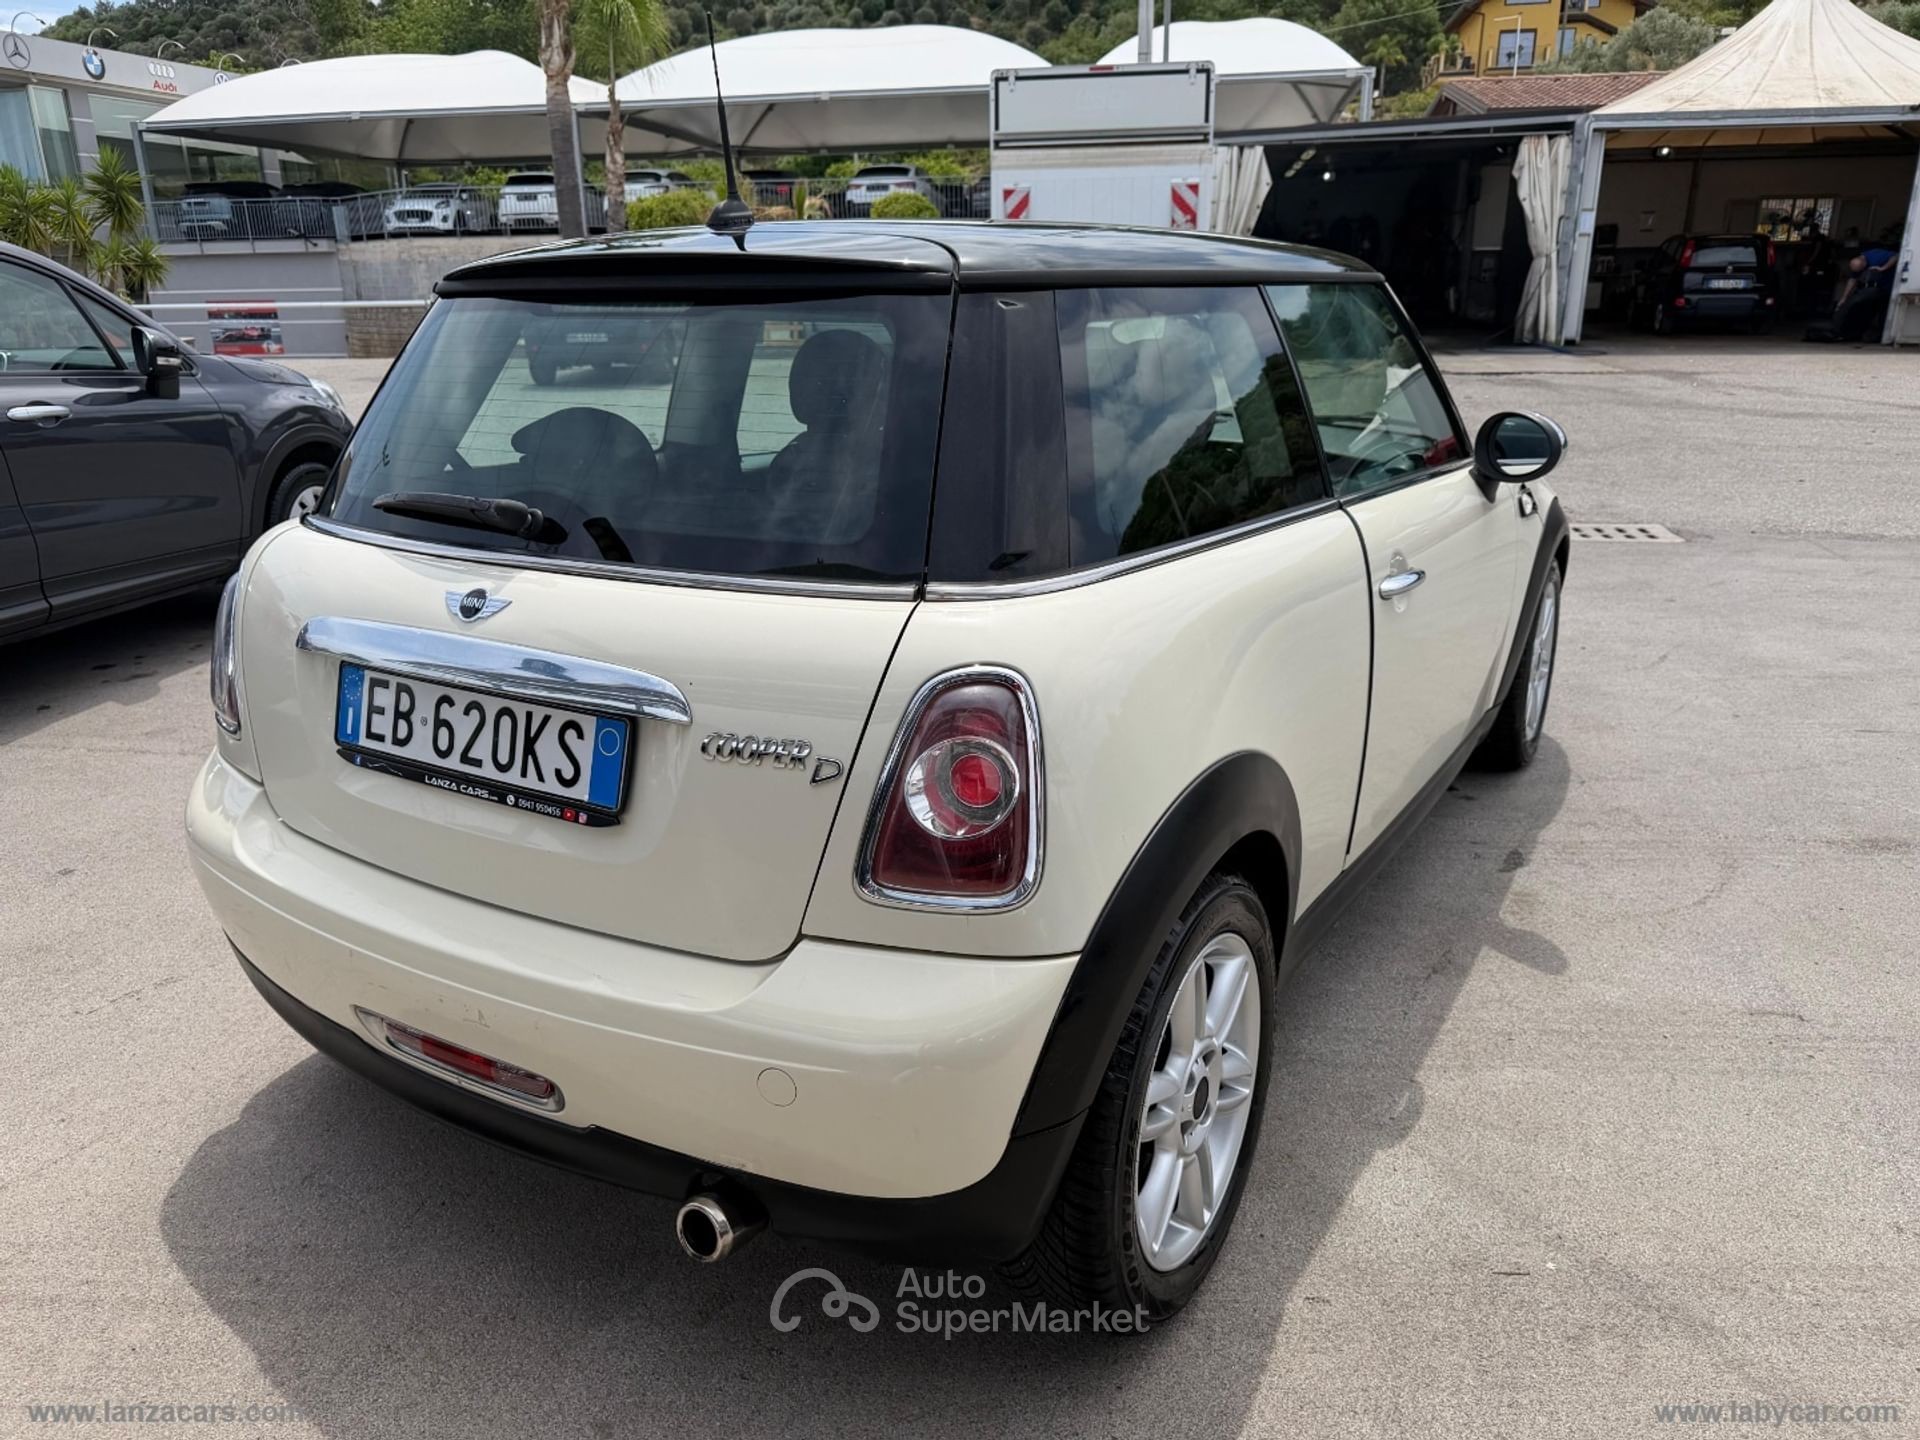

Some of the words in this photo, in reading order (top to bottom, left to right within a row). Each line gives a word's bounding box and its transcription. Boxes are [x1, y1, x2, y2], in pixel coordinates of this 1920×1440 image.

[153, 80, 178, 93] Audi
[463, 596, 485, 609] MINI
[365, 677, 416, 747] EB
[432, 694, 585, 788] 620KS
[701, 732, 812, 770] COOPER
[810, 756, 843, 784] D
[425, 775, 457, 790] LANZA
[460, 784, 489, 798] CARS
